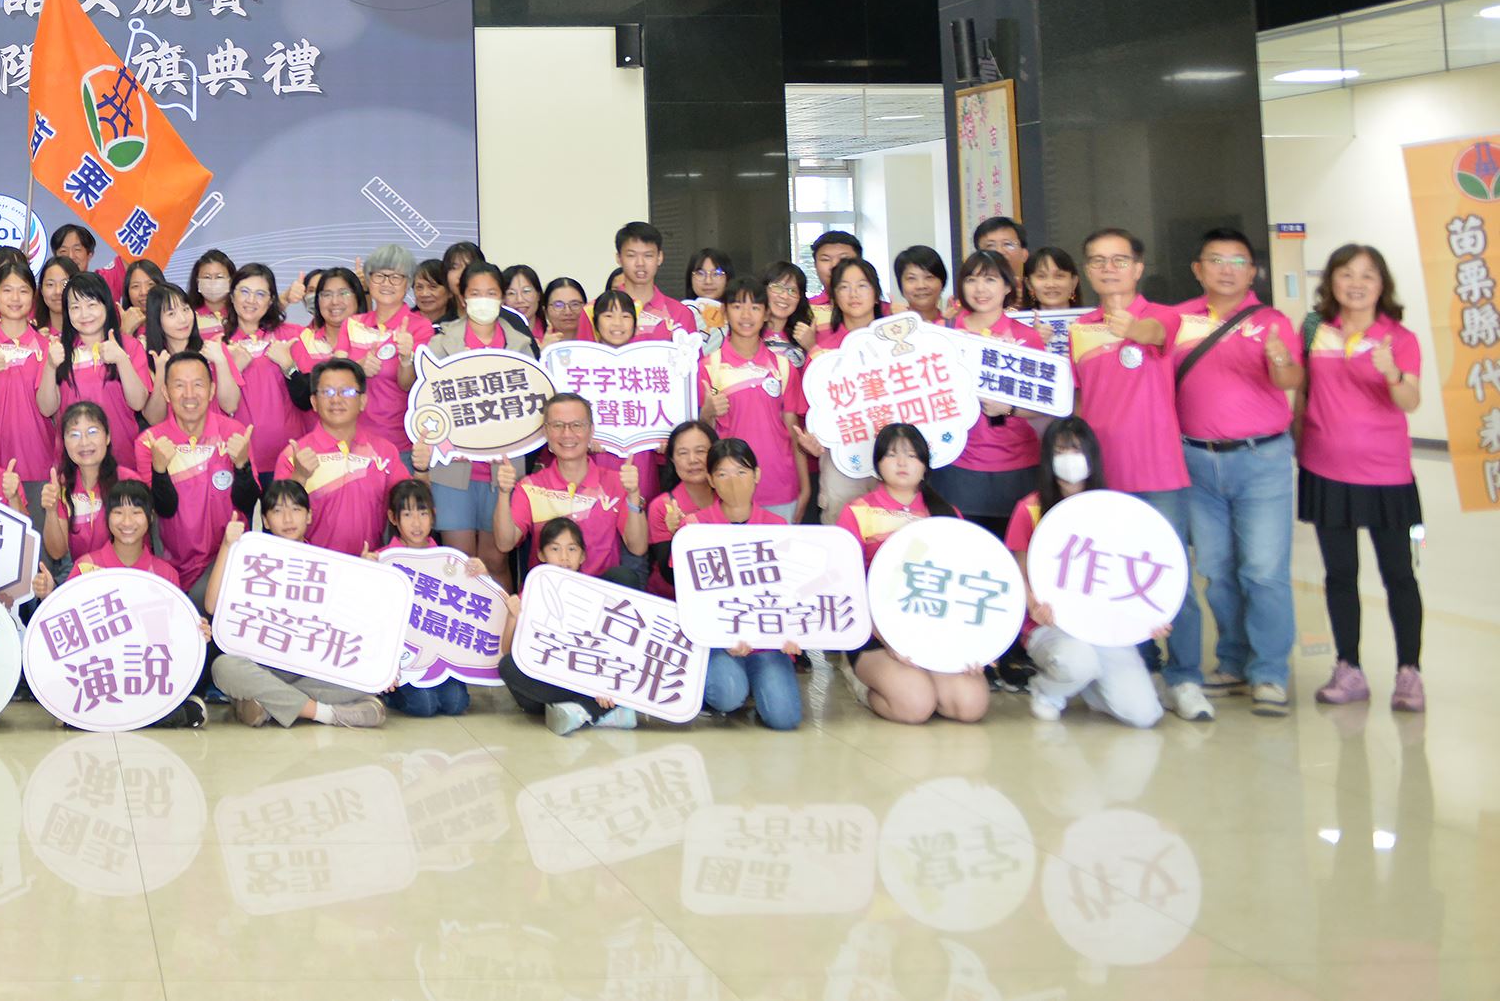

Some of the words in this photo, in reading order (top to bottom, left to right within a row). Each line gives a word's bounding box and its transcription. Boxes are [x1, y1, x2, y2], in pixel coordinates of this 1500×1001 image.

[566, 366, 670, 395] 字字珠璣
[827, 352, 951, 410] 妙筆生花
[451, 393, 547, 427] 語文骨力
[590, 399, 675, 428] 聲動人
[835, 388, 961, 446] 語驚四座
[243, 552, 329, 604] 客語
[686, 539, 782, 592] 國語
[898, 558, 1011, 627] 寫字
[1051, 533, 1174, 614] 作文
[39, 588, 134, 663] 國語
[226, 600, 363, 670] 字音字形
[604, 598, 697, 666] 台語
[717, 591, 855, 637] 字音字形
[65, 644, 175, 715] 演說
[527, 628, 688, 706] 字音字形
